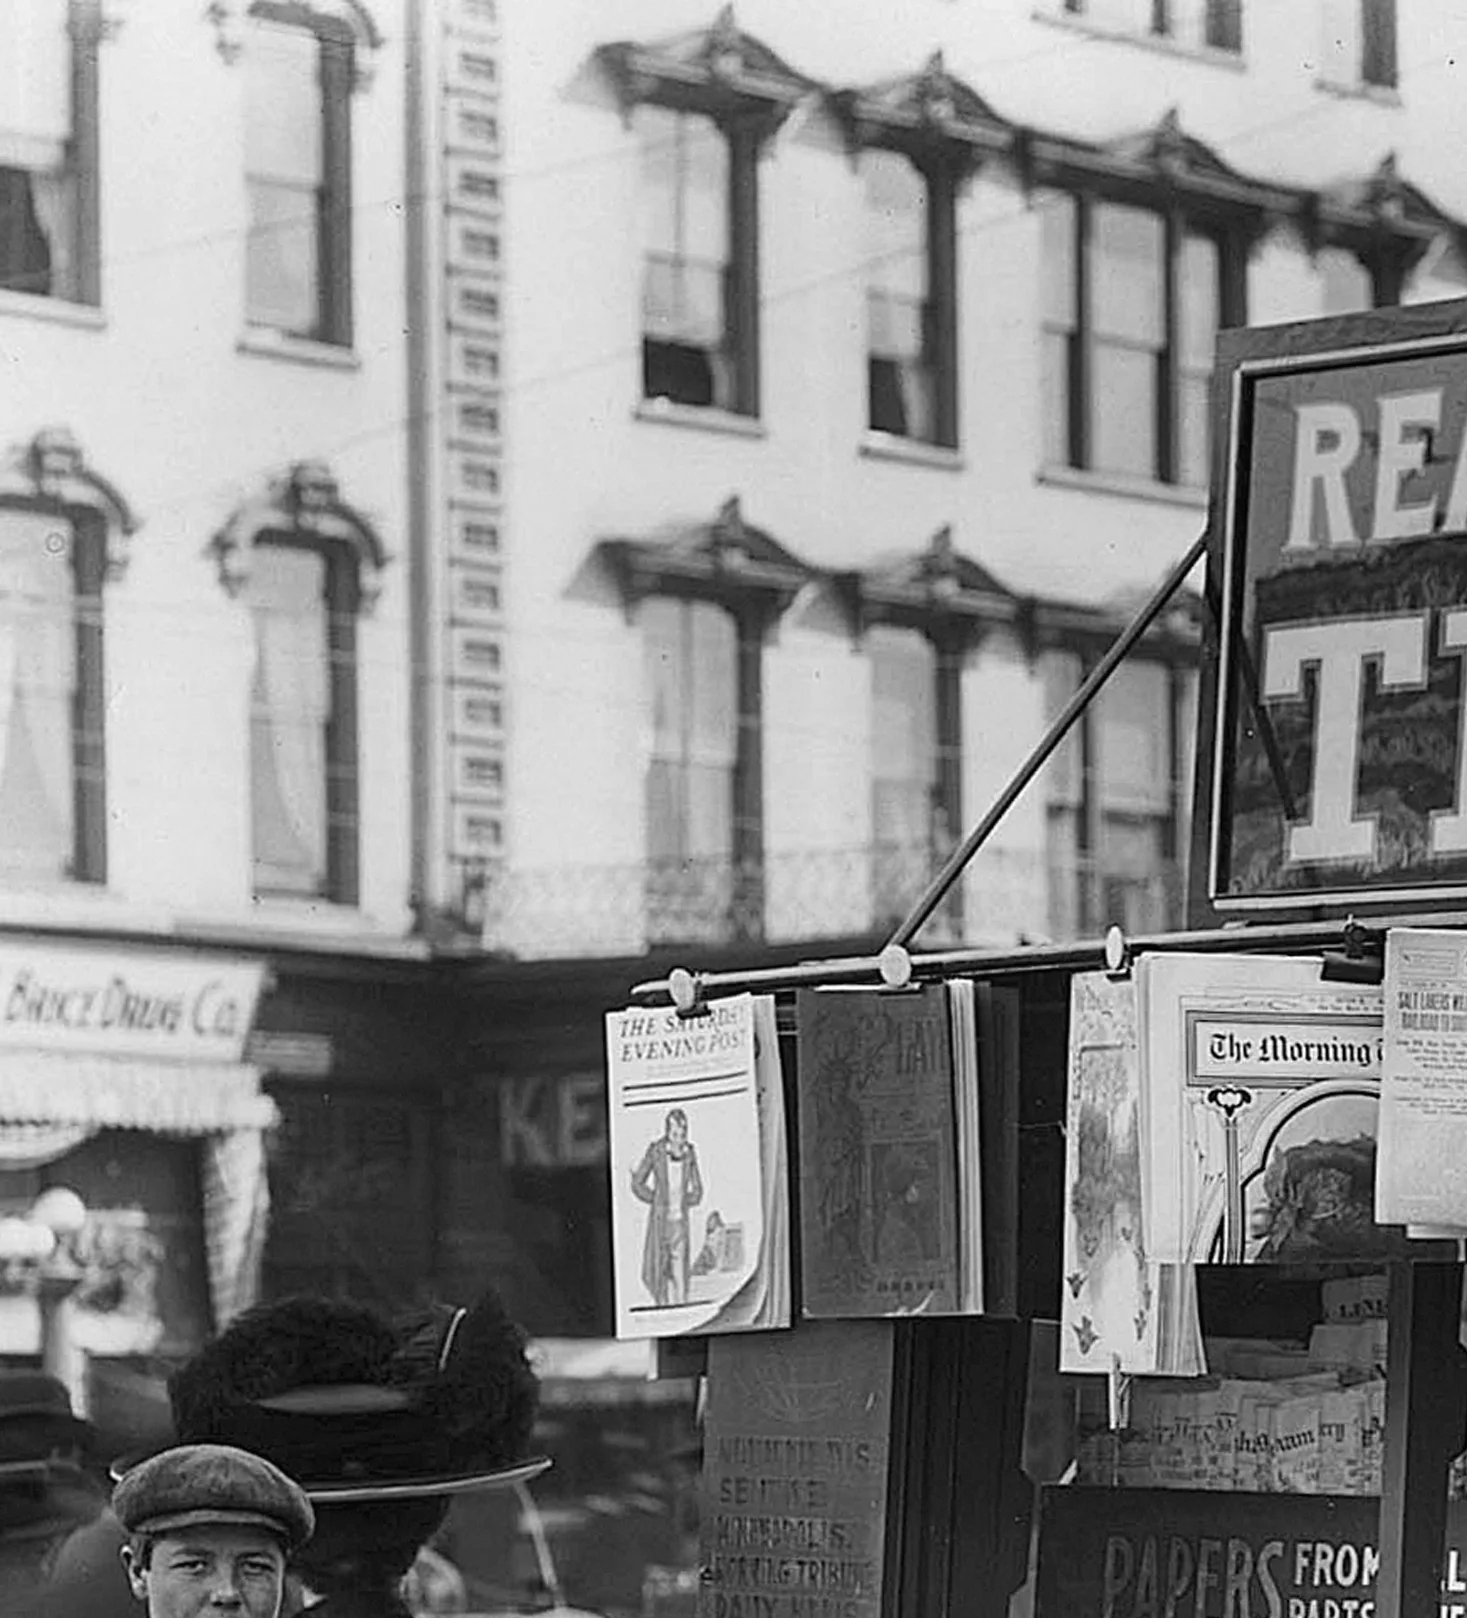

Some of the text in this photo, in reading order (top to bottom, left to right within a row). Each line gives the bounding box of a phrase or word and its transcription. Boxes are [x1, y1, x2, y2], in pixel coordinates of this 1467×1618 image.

[622, 1036, 706, 1063] EVENING
[1209, 1031, 1251, 1063] The
[1259, 1034, 1372, 1067] Morning
